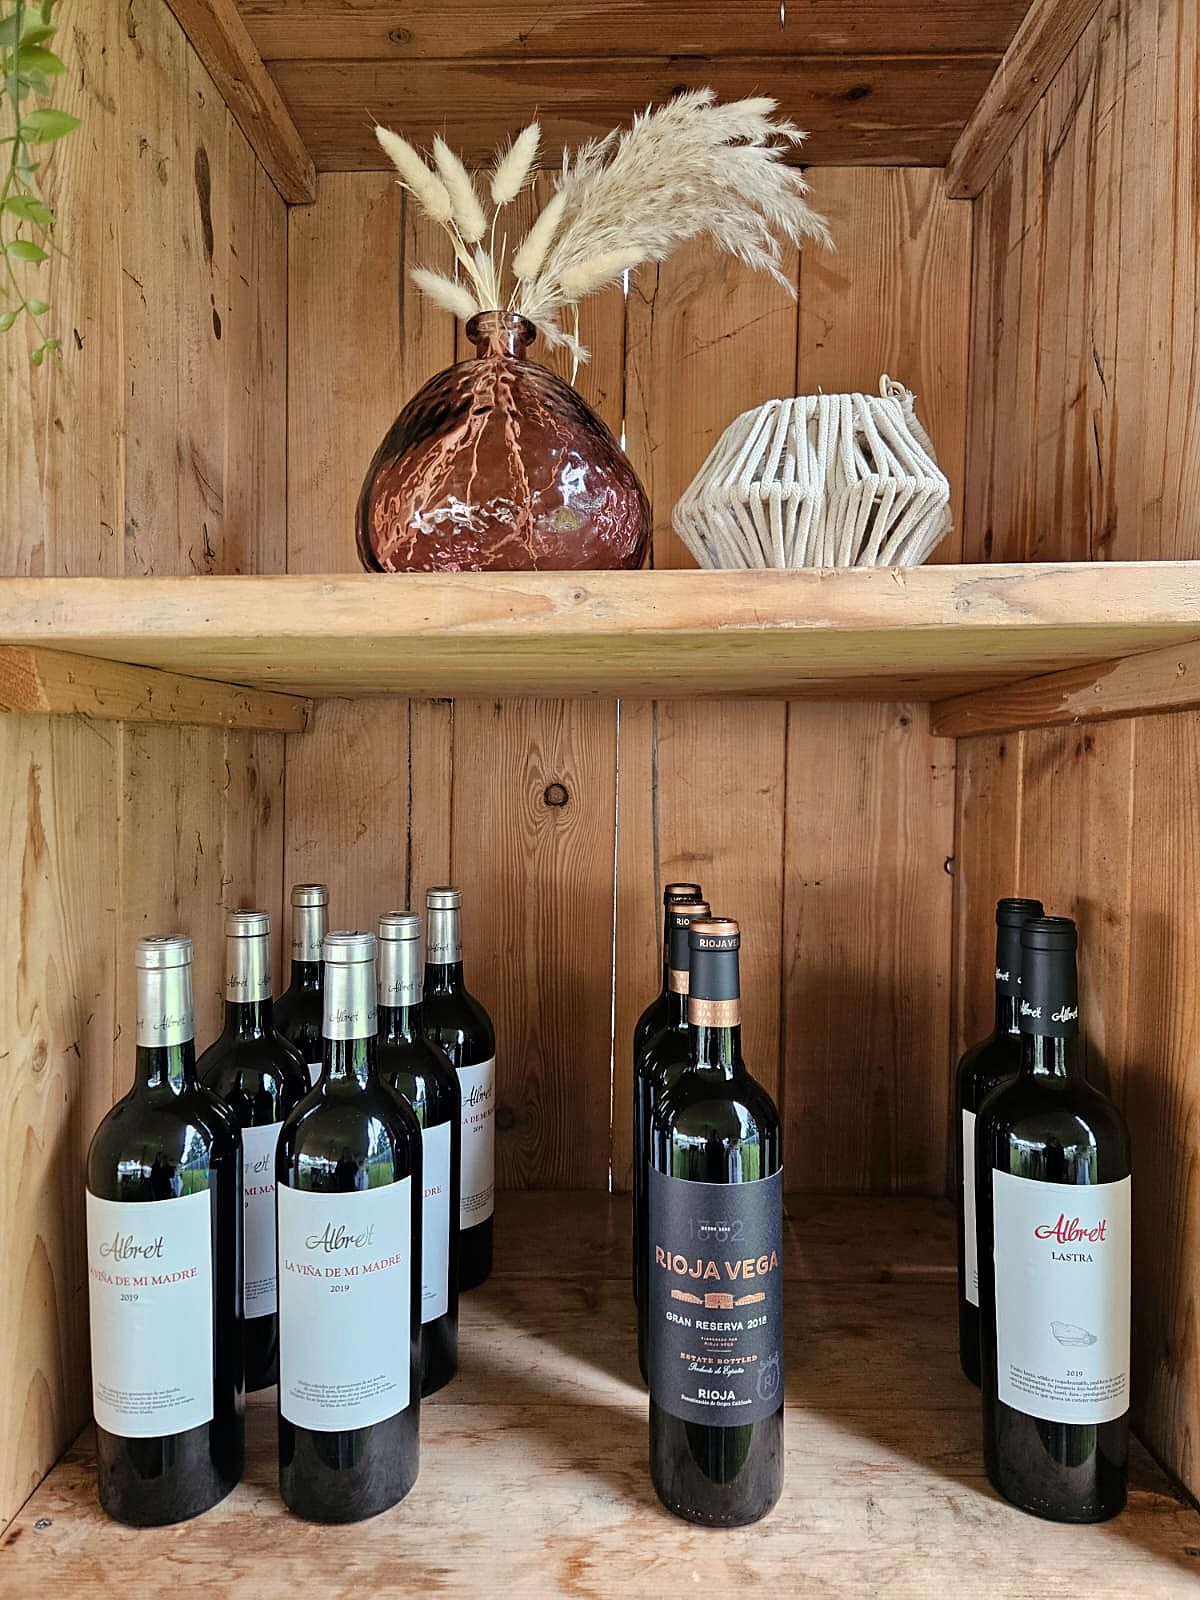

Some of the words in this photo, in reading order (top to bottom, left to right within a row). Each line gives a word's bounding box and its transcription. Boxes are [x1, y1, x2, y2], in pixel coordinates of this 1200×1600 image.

[676, 918, 690, 926] RIO
[699, 938, 727, 948] RIOJA
[424, 1185, 442, 1198] DRE
[1034, 1213, 1107, 1245] Albret
[305, 1221, 375, 1253] Albret
[99, 1231, 165, 1262] Albret
[655, 1244, 721, 1280] RIOJA
[724, 1249, 778, 1280] VEGA
[1051, 1251, 1094, 1263] LASTRA
[296, 1263, 322, 1278] VIÑA
[325, 1267, 341, 1278] DE
[344, 1266, 359, 1278] MI
[362, 1253, 402, 1275] MADRE
[115, 1276, 131, 1287] DE
[133, 1276, 149, 1287] MI
[151, 1266, 199, 1287] MADRE
[329, 1284, 351, 1293] 2019
[119, 1293, 140, 1302] 2019
[665, 1311, 692, 1328] GRAN
[695, 1320, 744, 1332] RESERVA
[680, 1352, 714, 1363] ESTATE
[717, 1354, 758, 1365] BOTTLED
[1066, 1369, 1084, 1378] 2019
[698, 1388, 736, 1401] RIOJA
